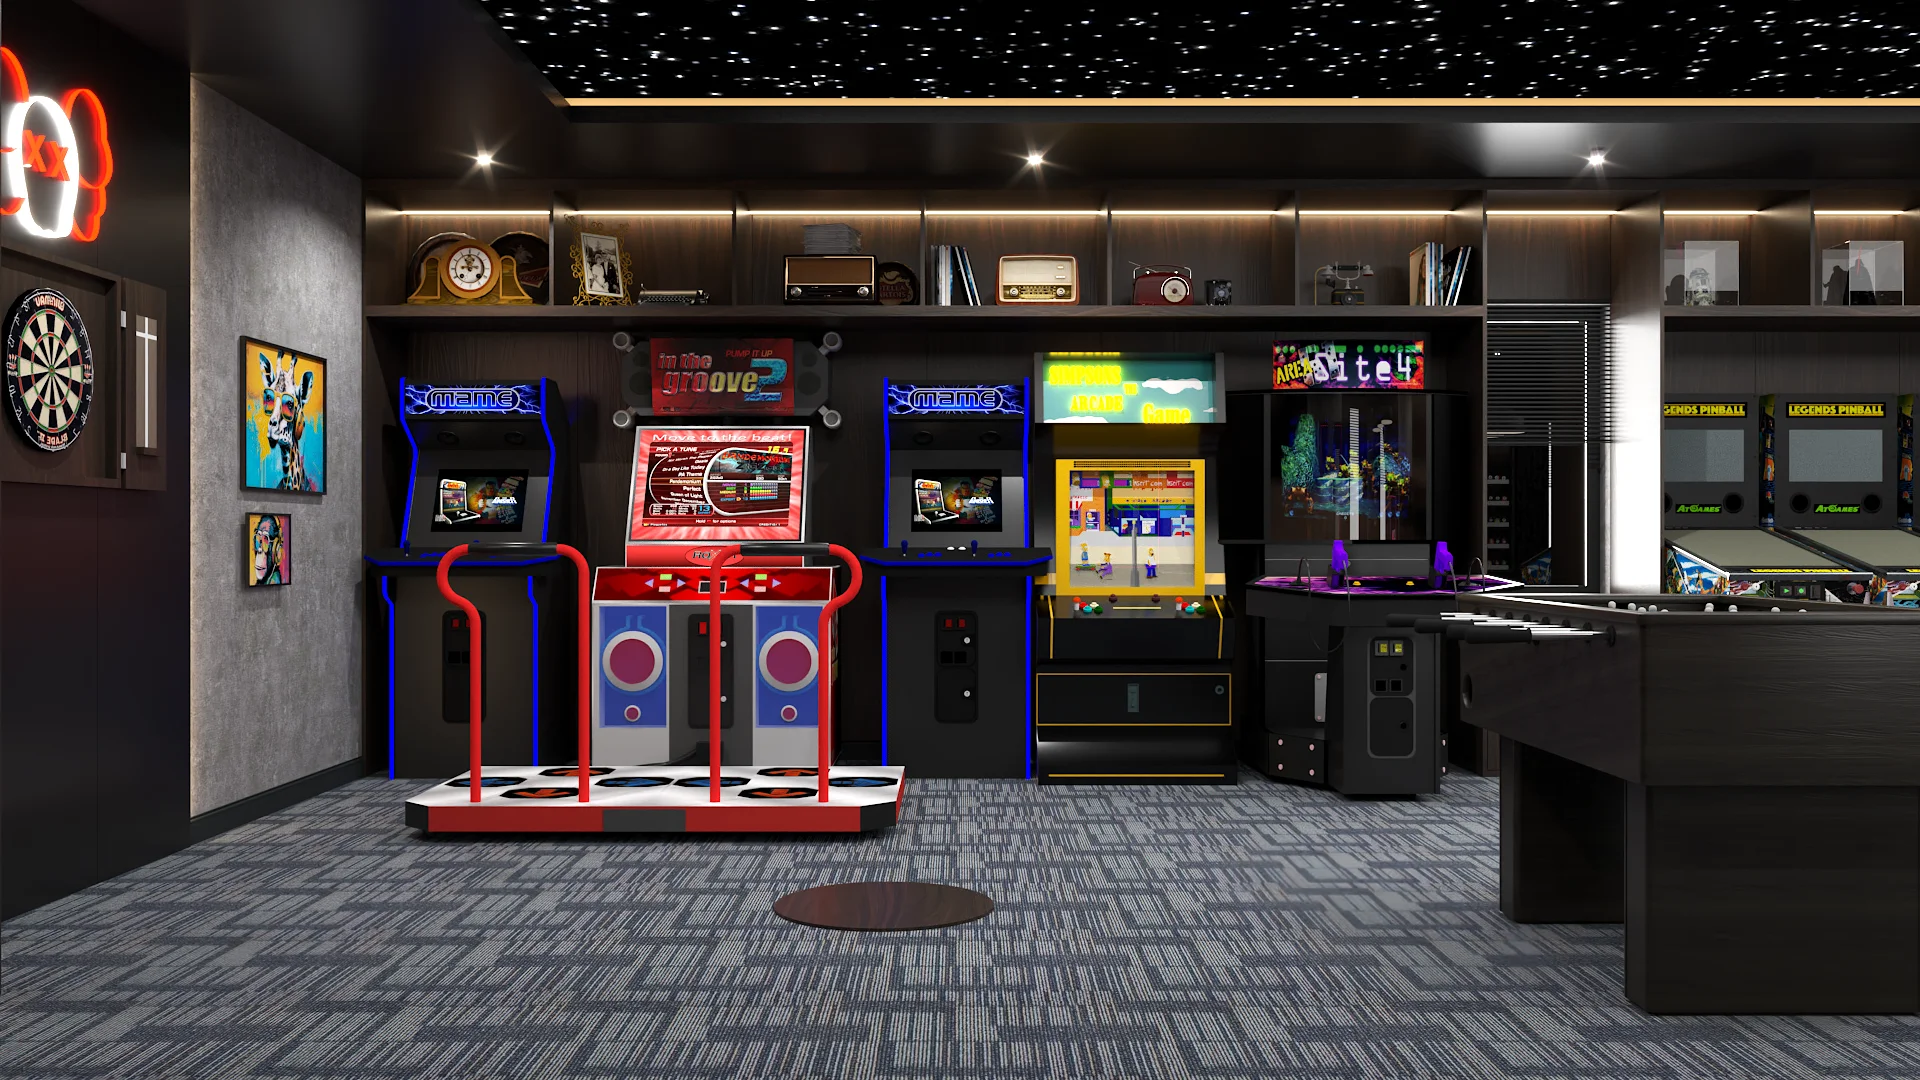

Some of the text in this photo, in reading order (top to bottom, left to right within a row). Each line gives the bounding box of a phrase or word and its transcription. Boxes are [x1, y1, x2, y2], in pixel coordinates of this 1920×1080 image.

[657, 352, 713, 370] in the
[662, 358, 788, 402] groove 2
[1048, 364, 1122, 386] SIMPSONS
[1277, 357, 1314, 385] AREA
[1069, 395, 1124, 412] ARCADE
[1700, 404, 1746, 415] PINBALL
[1788, 404, 1884, 415] LEGENDS PINBALL
[1141, 402, 1192, 424] Game
[652, 434, 792, 442] Move to the beat!
